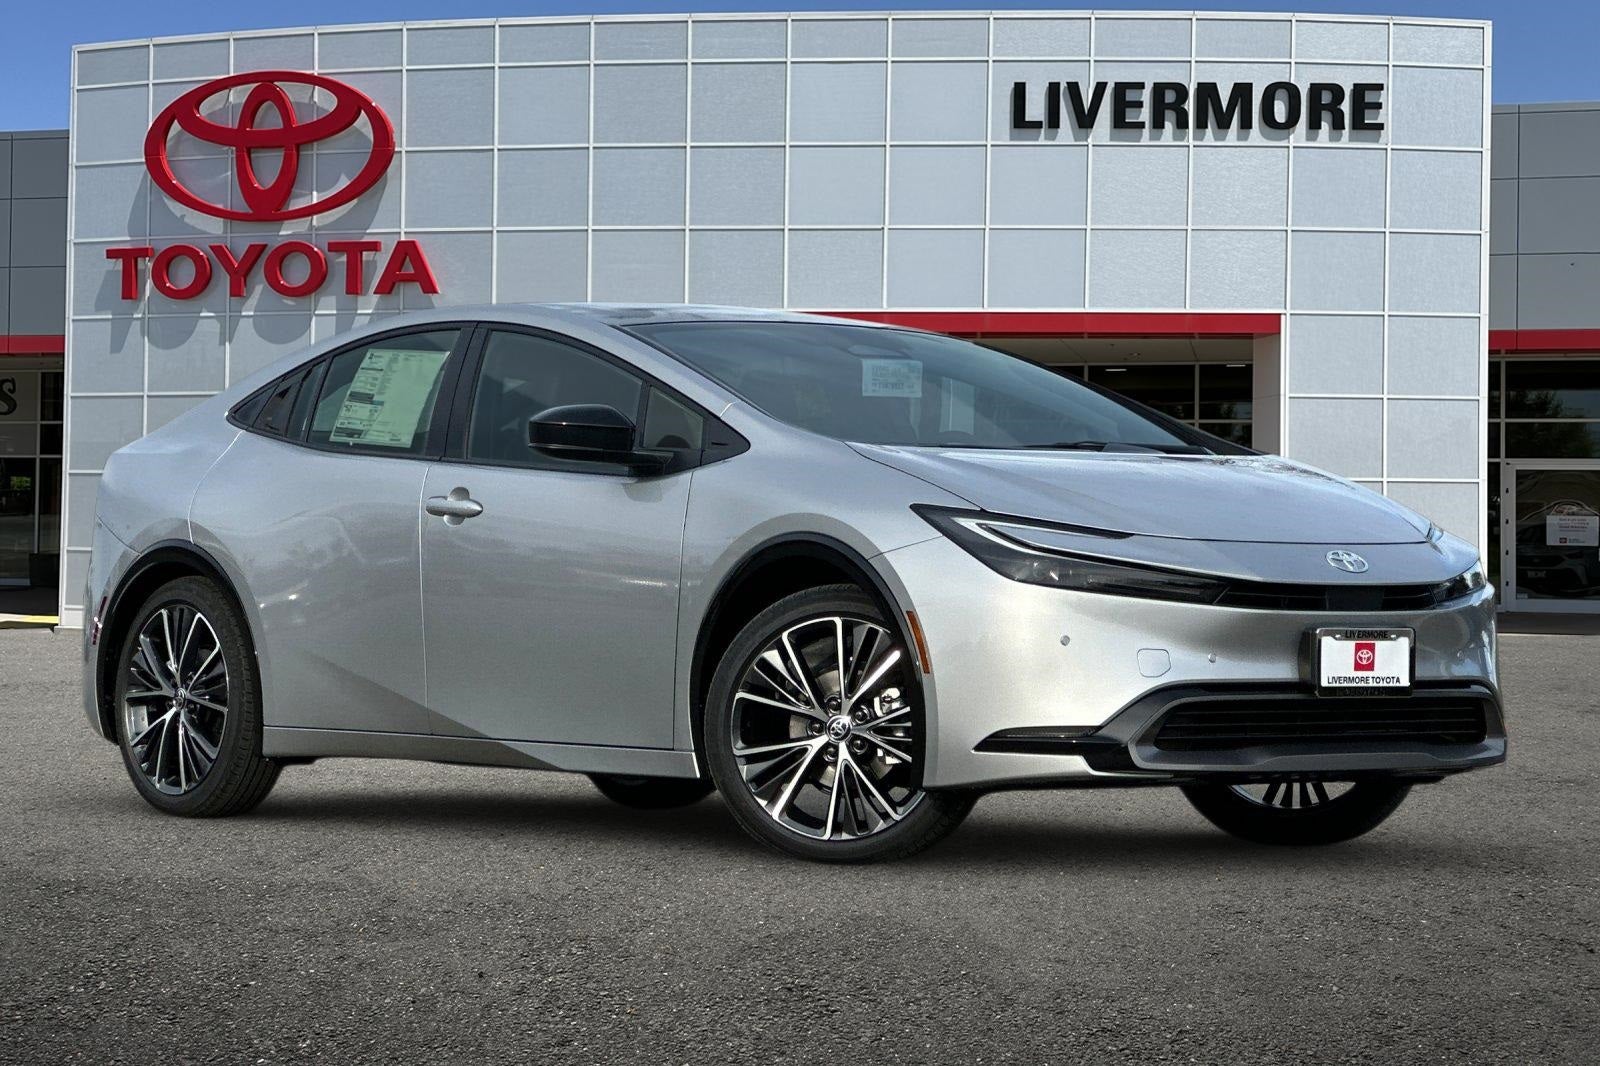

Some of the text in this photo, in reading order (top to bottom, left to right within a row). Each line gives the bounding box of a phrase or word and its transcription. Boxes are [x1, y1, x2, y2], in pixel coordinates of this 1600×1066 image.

[1013, 81, 1384, 130] LIVERMORE
[105, 240, 440, 300] TOYOTA
[1345, 630, 1388, 639] LIVERMORE
[1327, 676, 1401, 685] LIVERMORE TOYOTA
